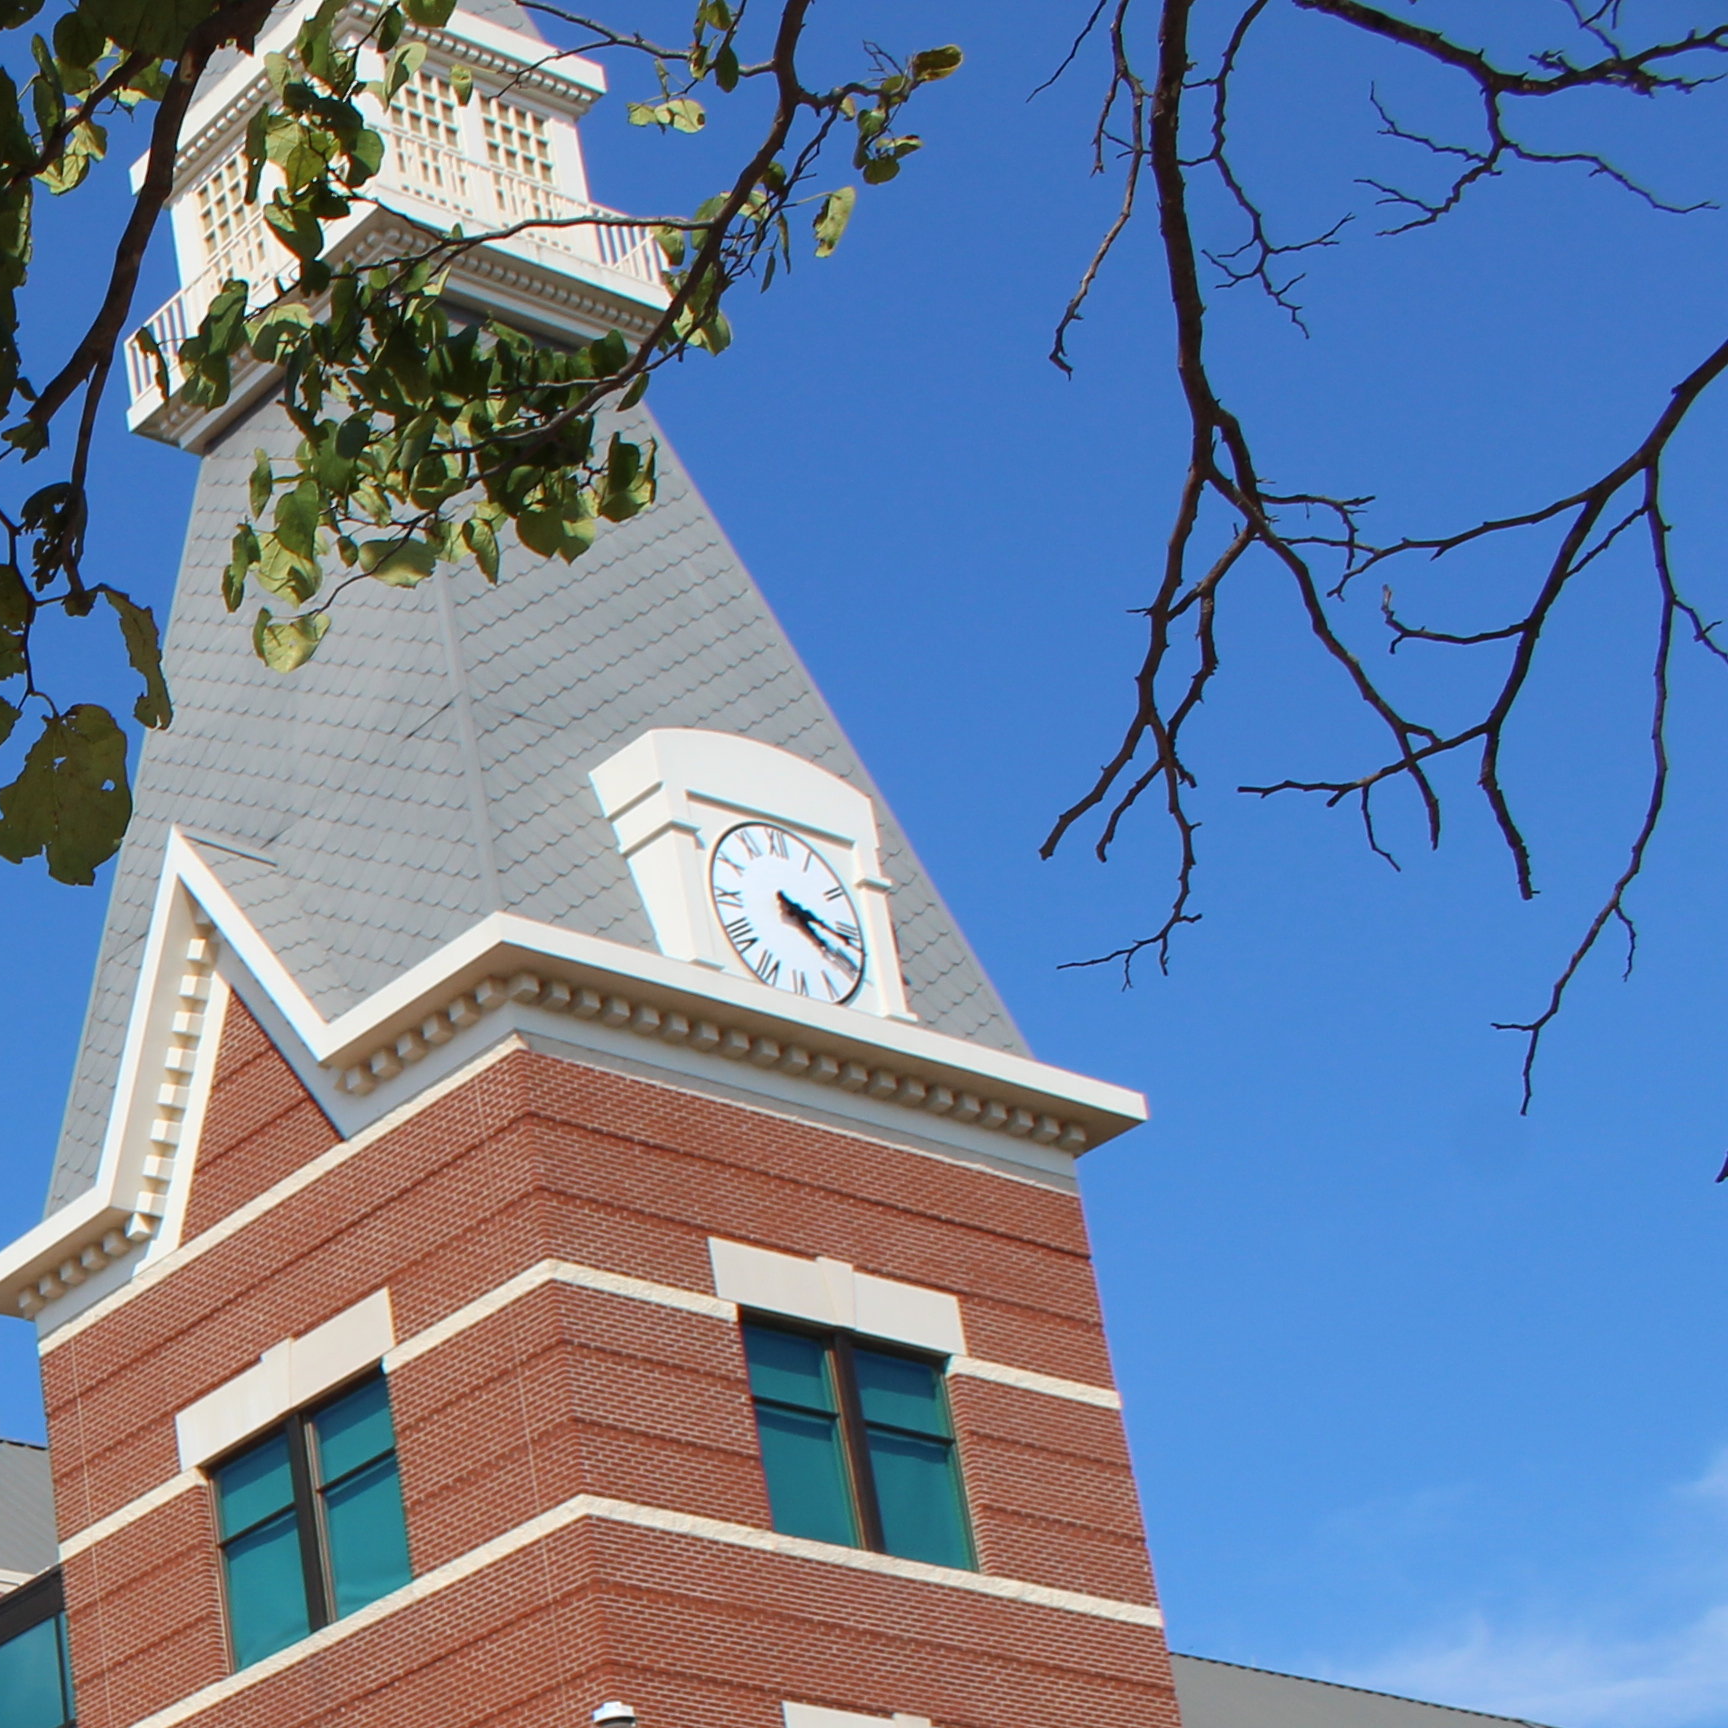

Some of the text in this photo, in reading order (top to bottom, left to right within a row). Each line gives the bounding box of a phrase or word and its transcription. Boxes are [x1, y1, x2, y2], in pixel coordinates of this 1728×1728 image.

[734, 829, 762, 861] XI
[764, 827, 789, 860] XII
[716, 850, 745, 878] X
[714, 886, 743, 908] IX
